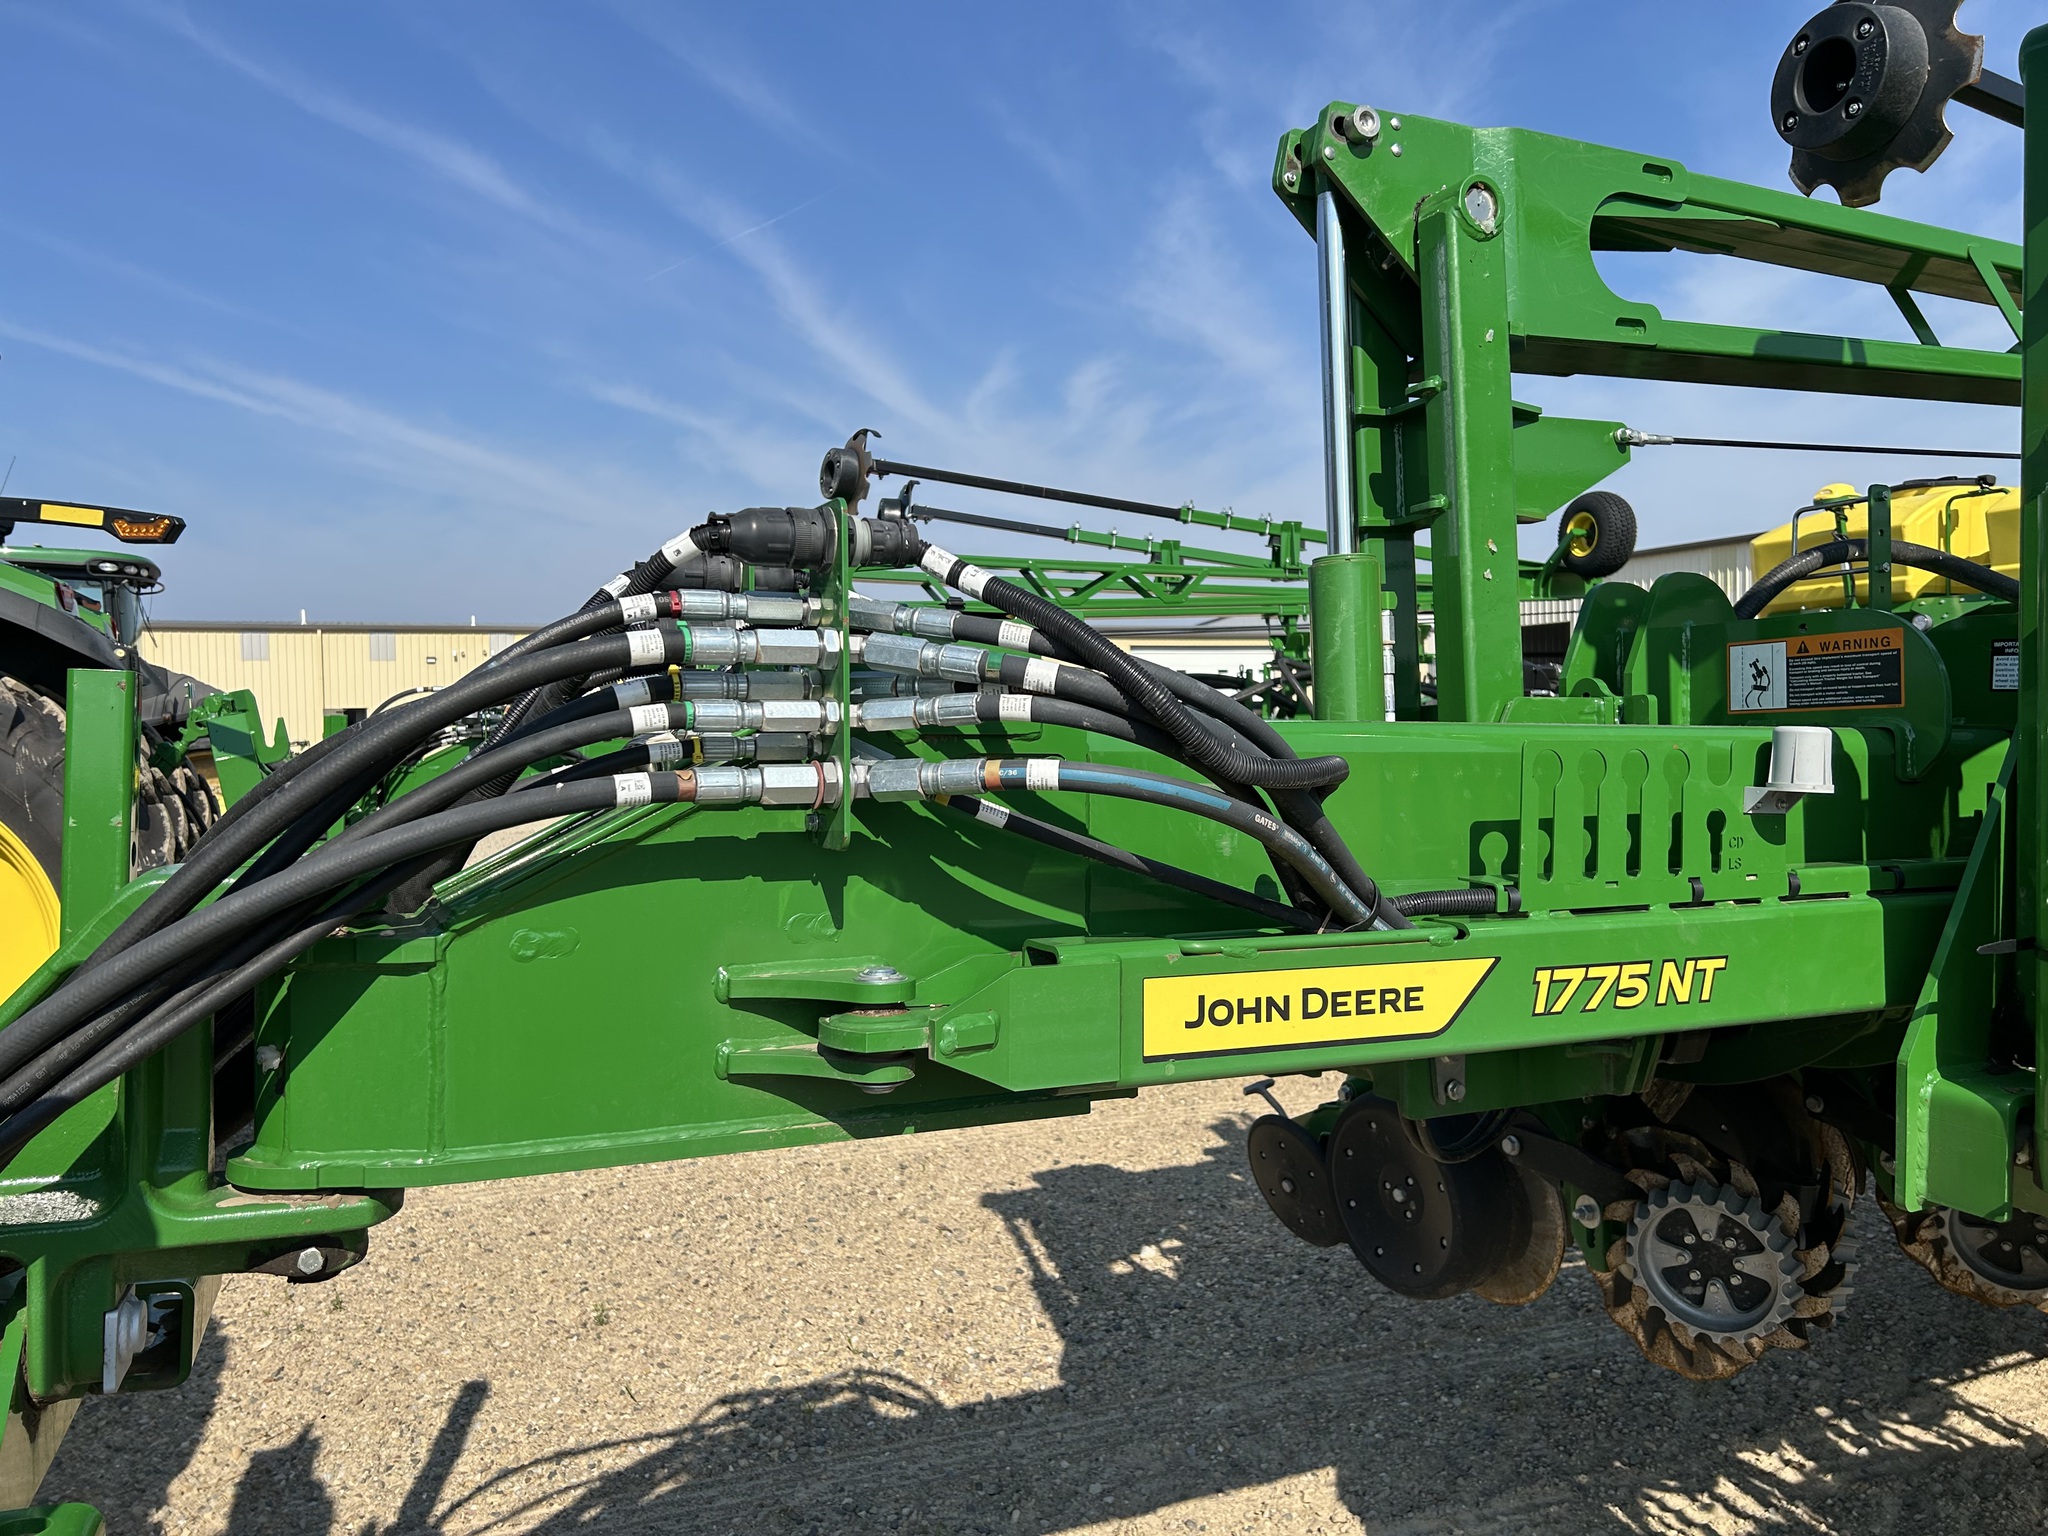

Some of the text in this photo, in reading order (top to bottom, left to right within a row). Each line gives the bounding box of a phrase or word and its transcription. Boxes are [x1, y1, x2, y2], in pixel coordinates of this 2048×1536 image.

[1819, 636, 1891, 652] WARNING
[1729, 836, 1744, 848] CD
[1728, 858, 1742, 870] LS
[1532, 955, 1729, 1017] 1775 NT
[1184, 986, 1424, 1029] JOHN DEERE
